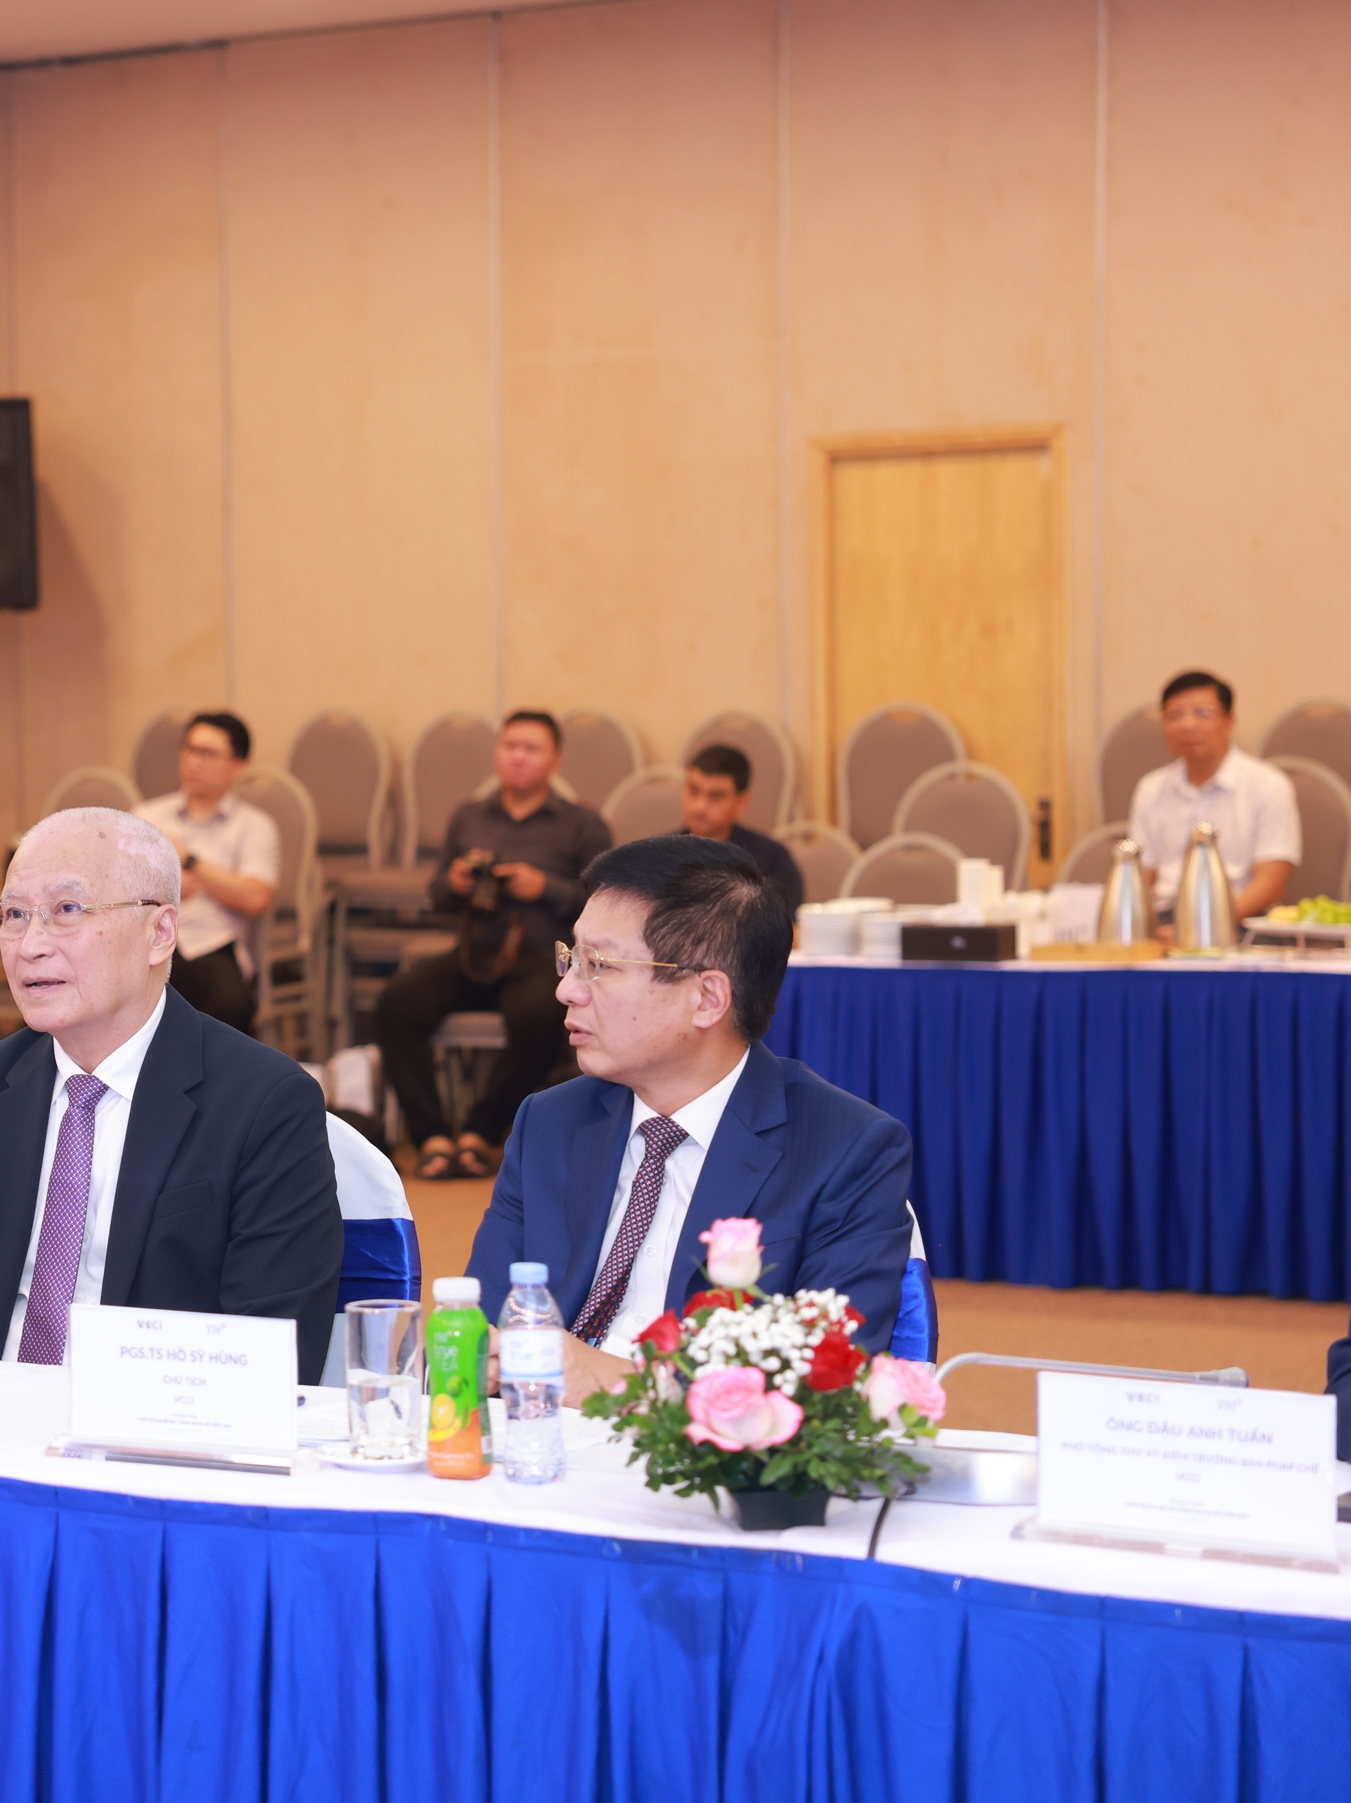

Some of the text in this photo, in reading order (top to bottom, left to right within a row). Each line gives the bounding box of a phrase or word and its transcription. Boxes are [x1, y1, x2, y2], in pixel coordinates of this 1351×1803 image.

[120, 1346, 163, 1360] PGS.TS
[166, 1346, 187, 1362] HỒ
[208, 1349, 248, 1366] HÙNG
